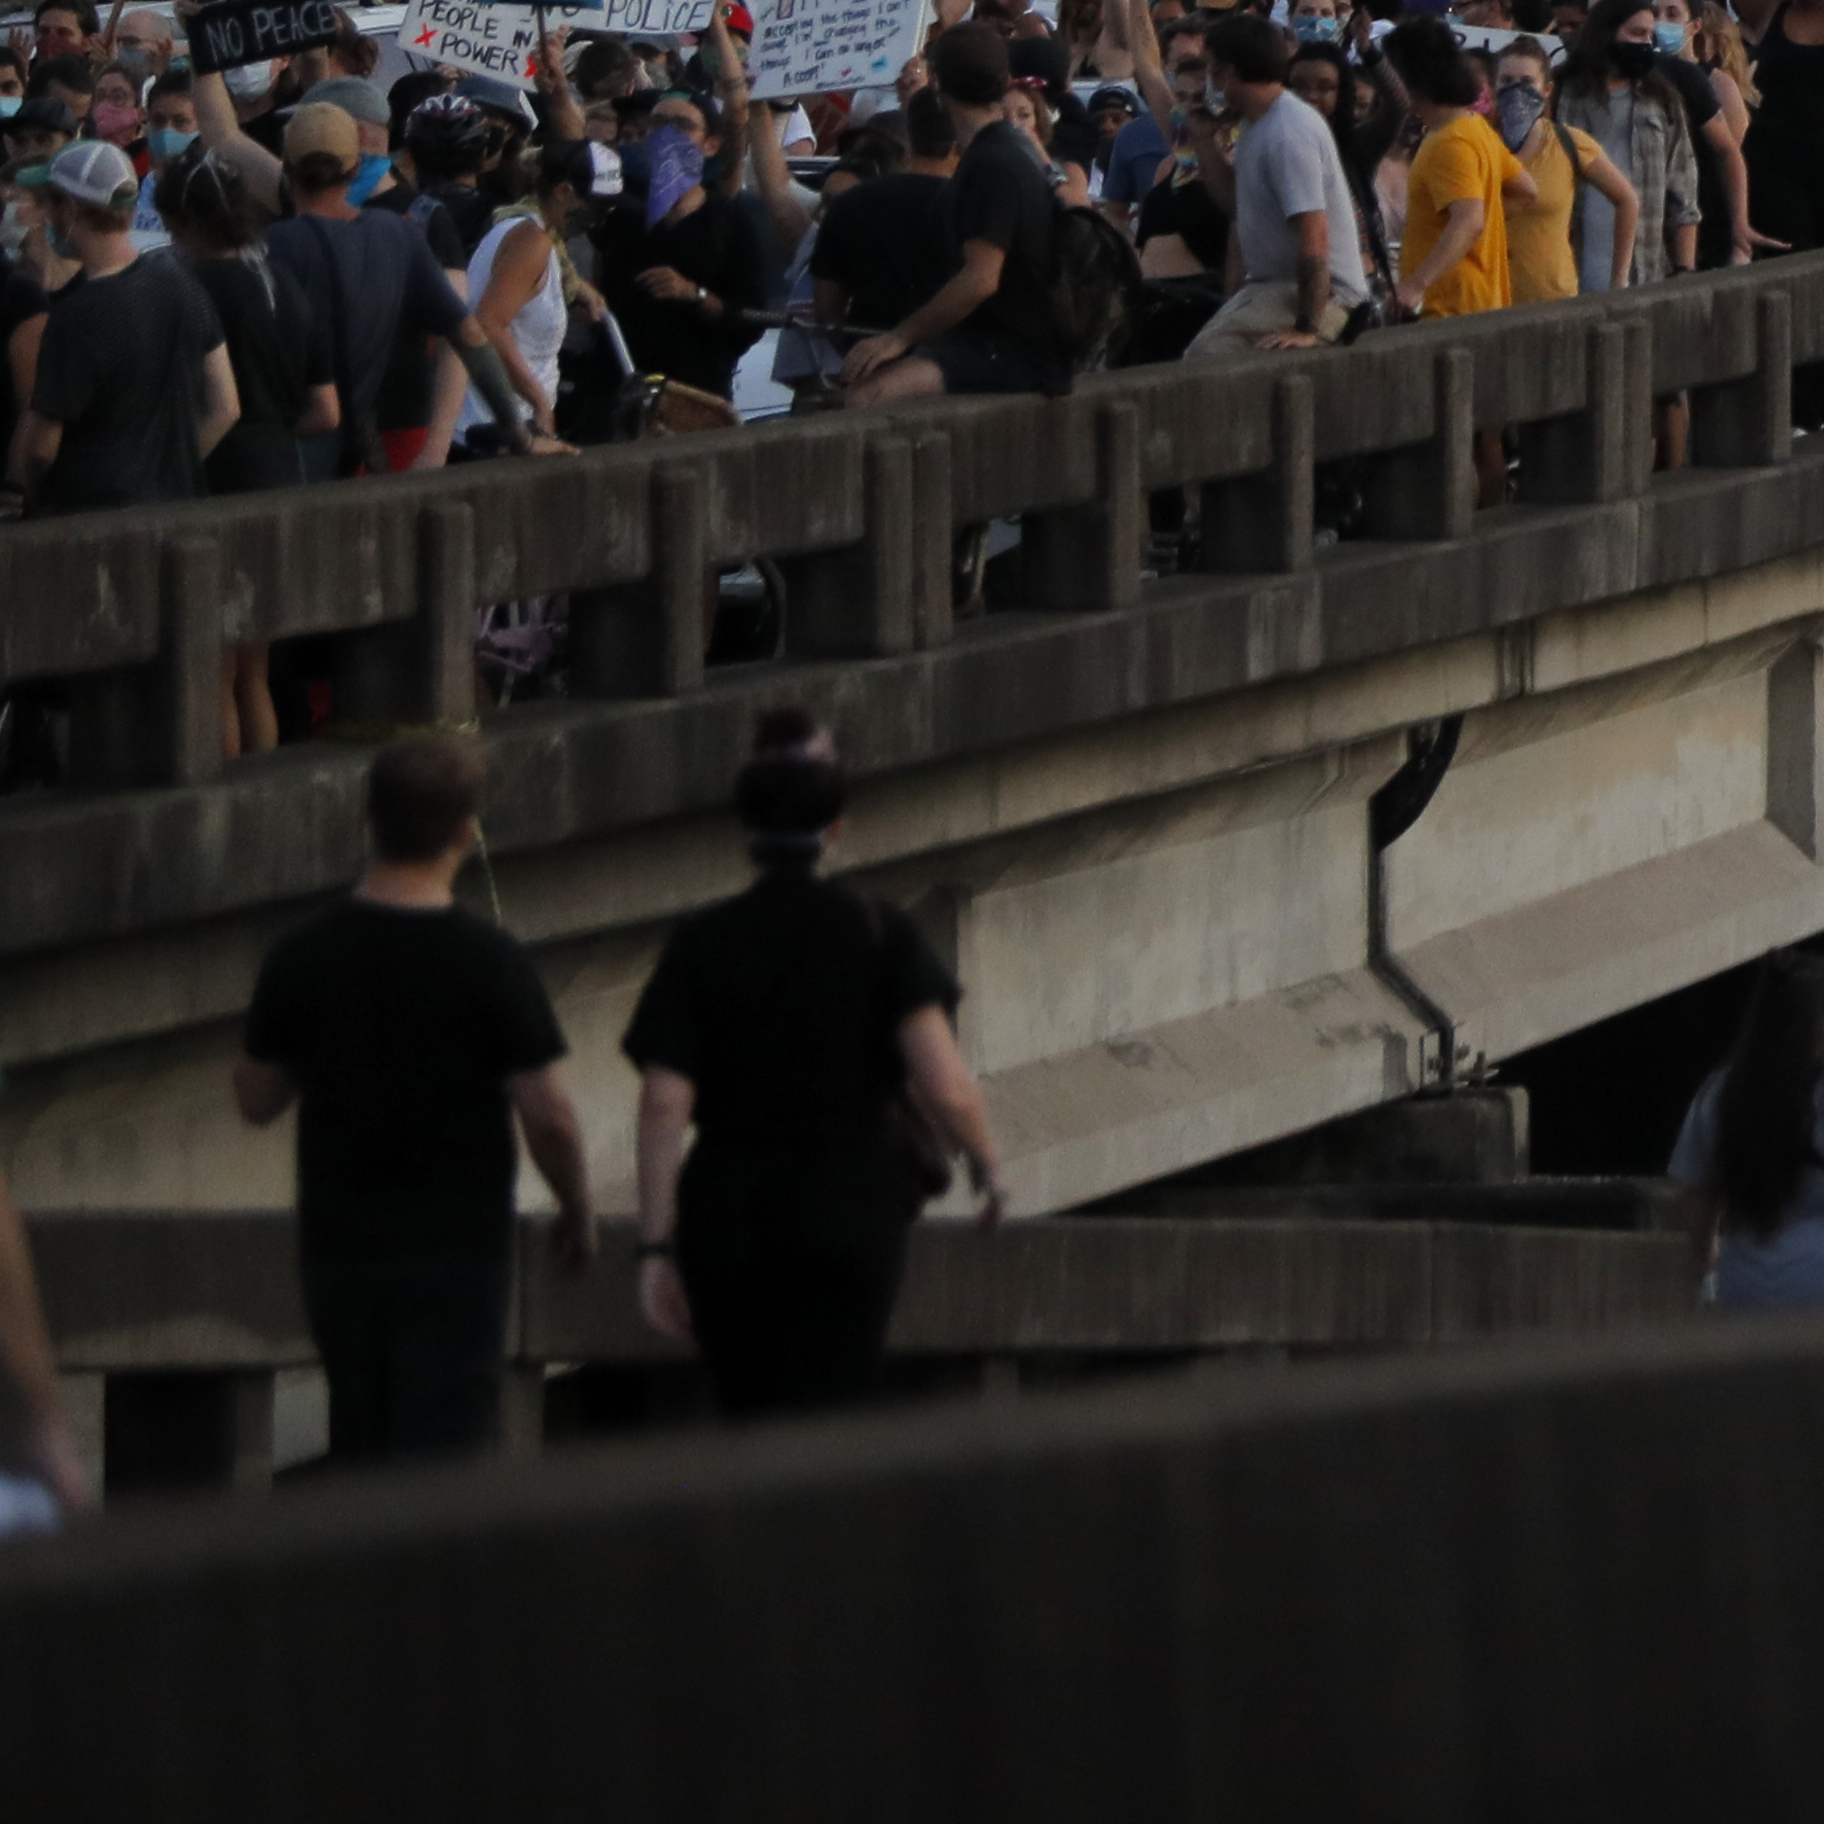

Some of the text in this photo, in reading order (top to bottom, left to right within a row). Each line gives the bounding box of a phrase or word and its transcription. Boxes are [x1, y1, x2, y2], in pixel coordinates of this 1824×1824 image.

[205, 0, 337, 65] NO PEACE
[440, 33, 518, 76] POWER
